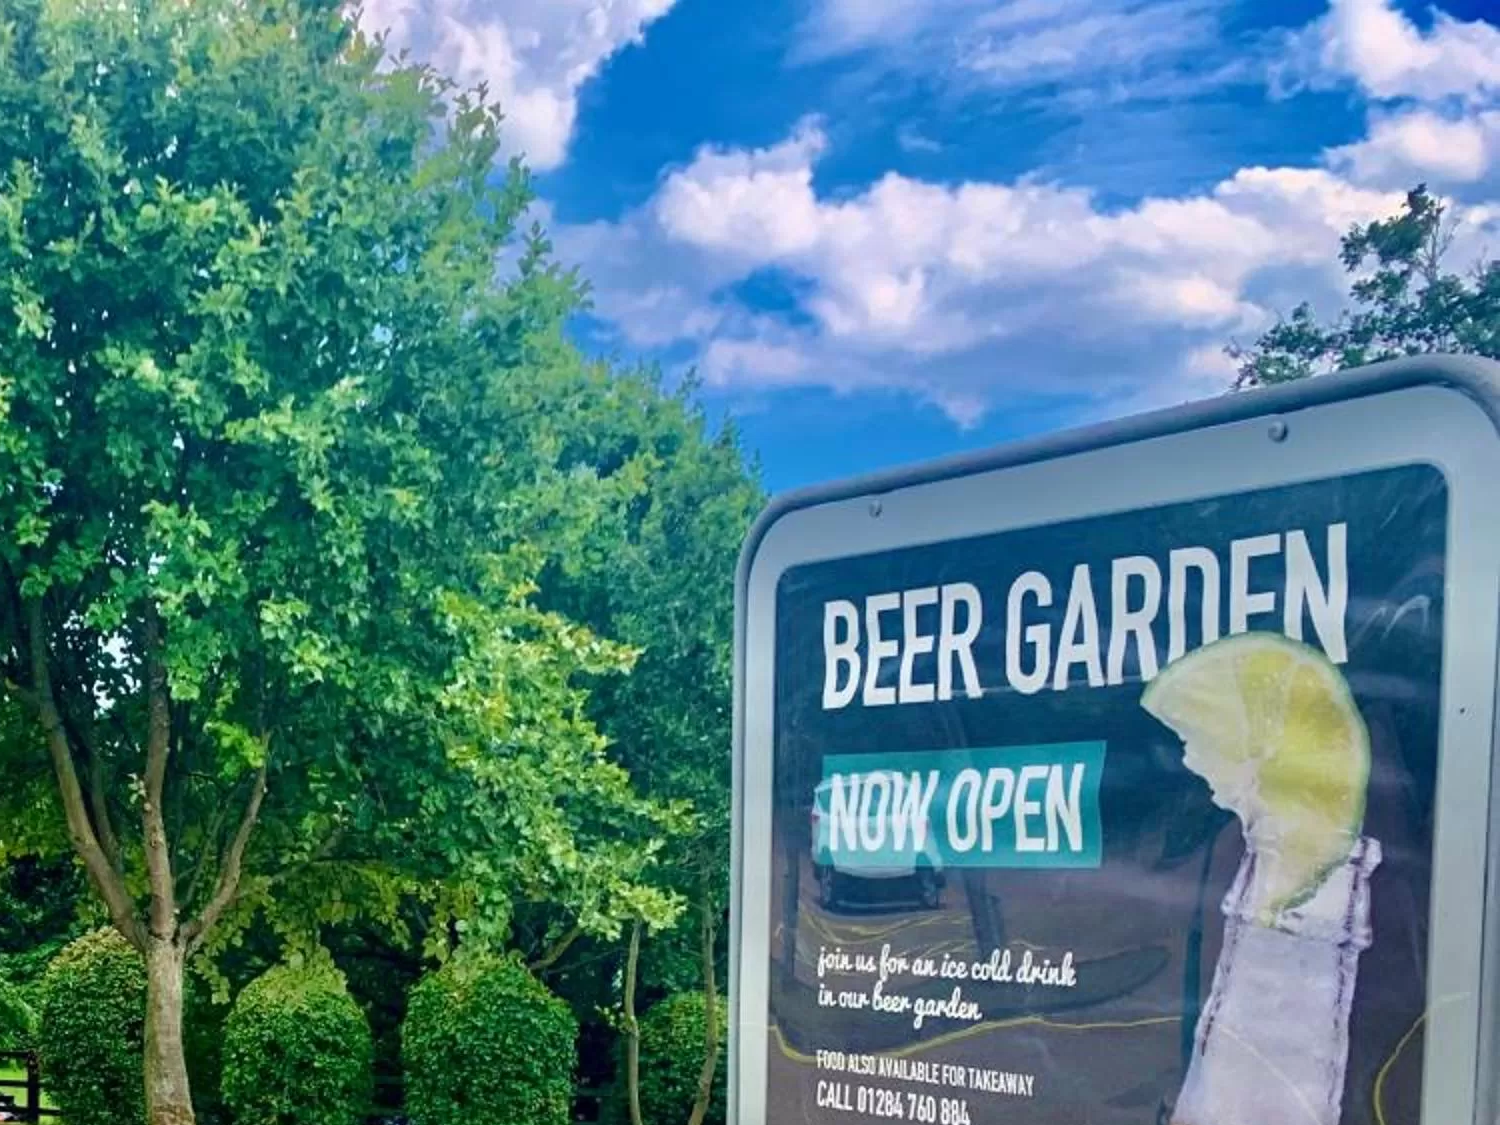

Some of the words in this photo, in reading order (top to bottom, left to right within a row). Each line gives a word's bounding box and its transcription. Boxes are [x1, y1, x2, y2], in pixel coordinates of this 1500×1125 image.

[822, 582, 982, 710] BEER
[1005, 522, 1348, 694] GARDEN
[828, 769, 940, 853] NOW
[947, 763, 1085, 852] OPEN
[818, 946, 852, 977] join
[855, 954, 876, 973] us
[878, 943, 910, 982] for
[911, 957, 939, 978] an
[940, 953, 968, 979] ice
[971, 948, 1013, 983] cold
[1015, 949, 1077, 987] drink
[818, 983, 837, 1008] in
[838, 989, 870, 1009] our
[871, 980, 912, 1013] beer
[913, 986, 983, 1030] garden
[816, 1049, 845, 1071] FOOD
[849, 1053, 876, 1076] ALSO
[878, 1057, 940, 1085] AVAILABLE
[941, 1064, 966, 1088] FOR
[968, 1068, 1035, 1097] TAKEAWAY
[816, 1080, 853, 1111] CALL
[857, 1086, 904, 1119] 01284
[907, 1093, 937, 1124] 760
